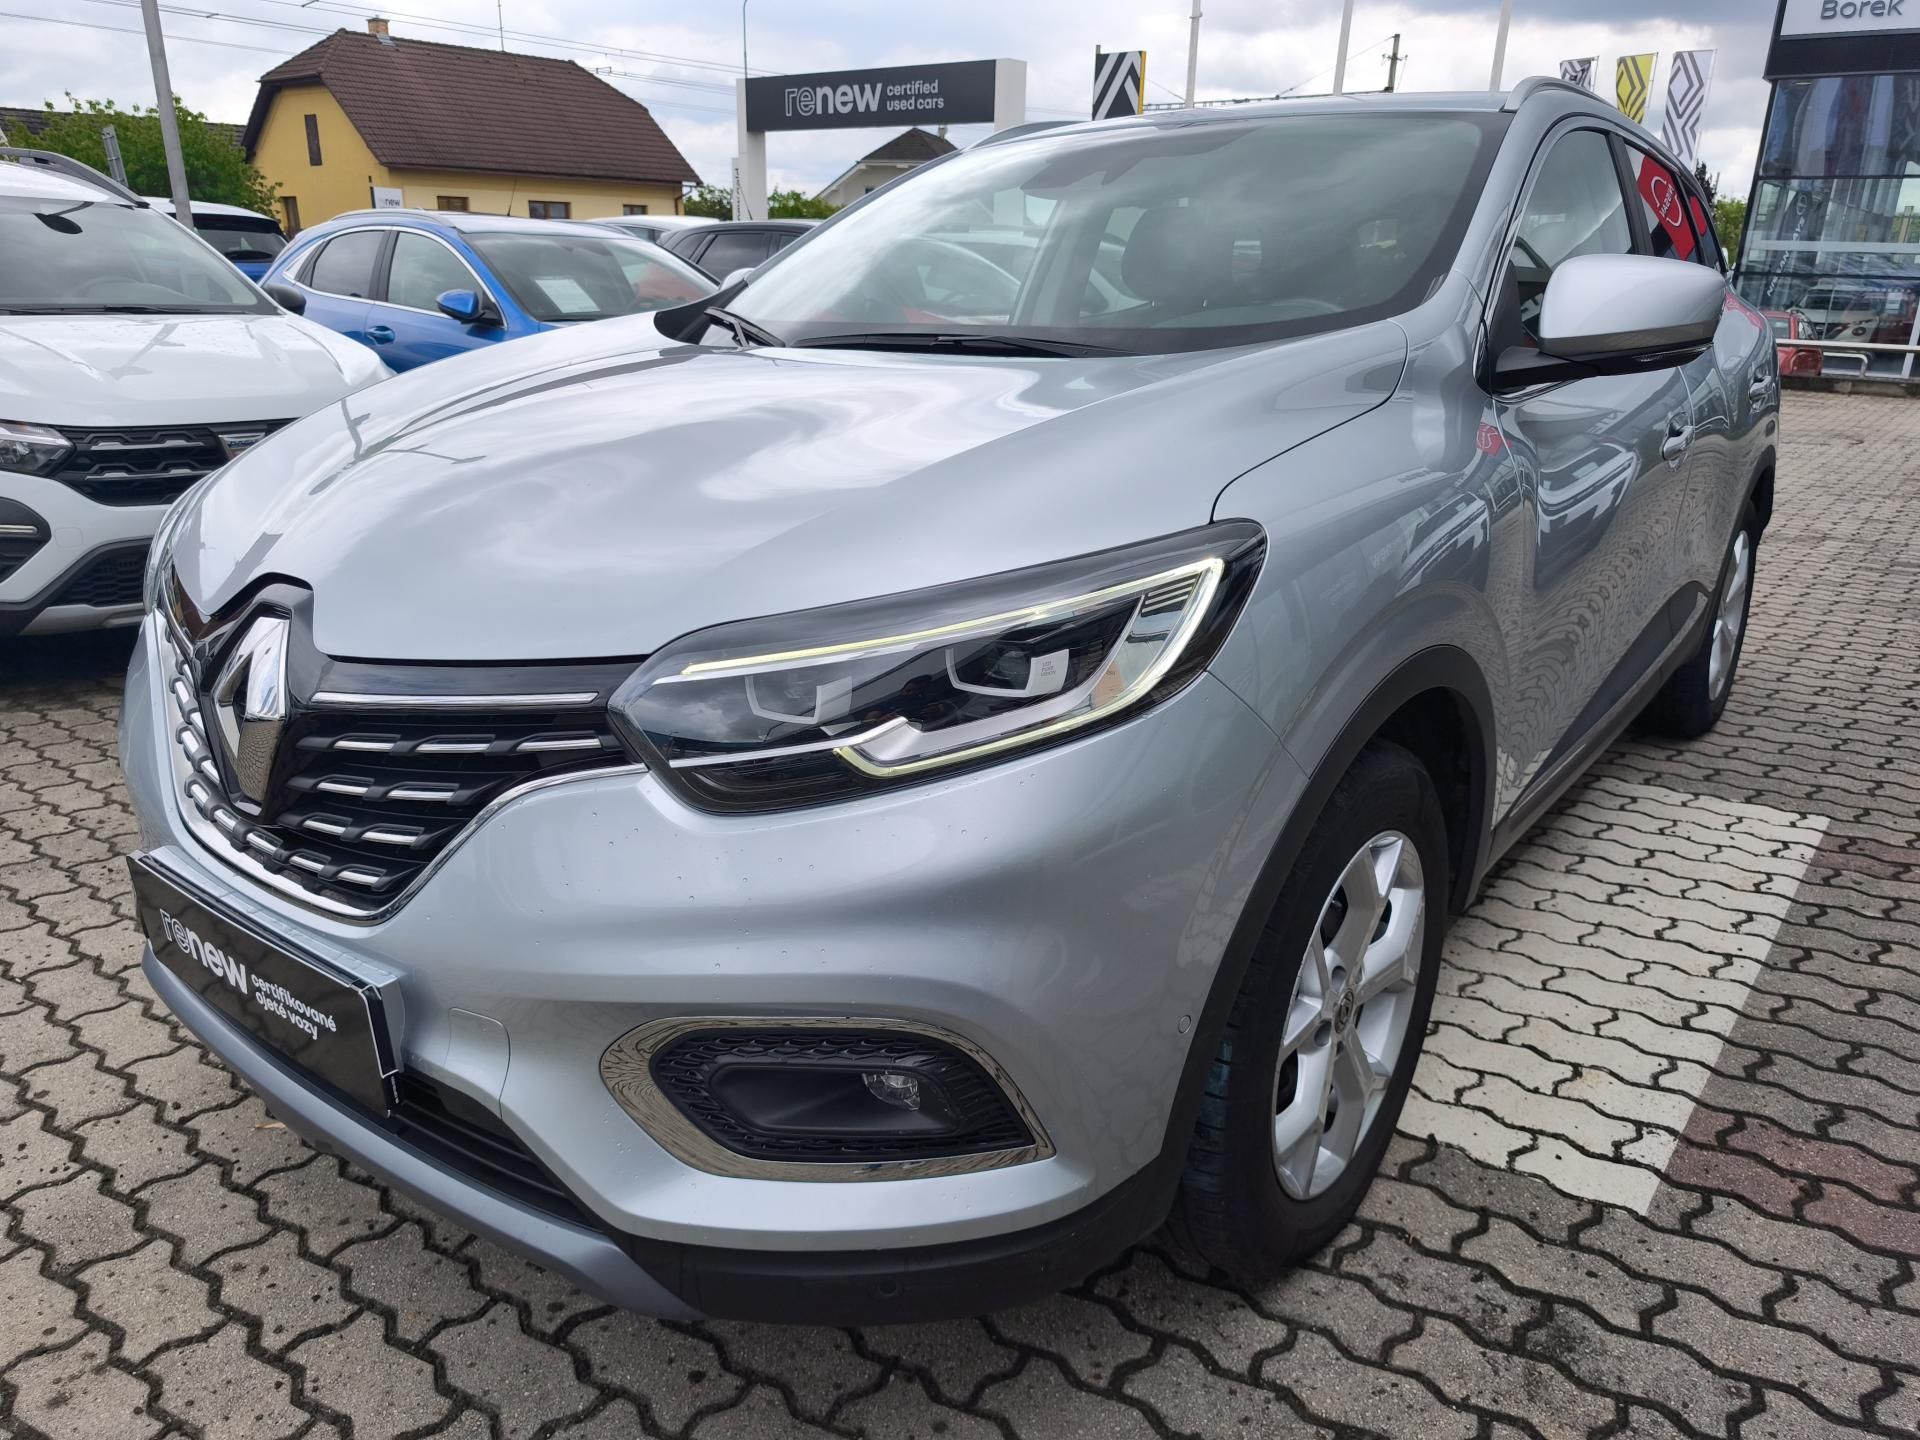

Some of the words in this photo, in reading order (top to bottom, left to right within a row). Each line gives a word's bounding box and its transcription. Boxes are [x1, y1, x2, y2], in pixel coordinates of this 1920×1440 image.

[1820, 0, 1905, 20] Borek
[784, 82, 883, 117] renew
[886, 79, 939, 97] certified
[886, 96, 915, 111] used
[916, 95, 945, 111] cars
[159, 908, 248, 995] renew
[251, 972, 337, 1033] certifikované
[255, 991, 287, 1020] ojeté
[286, 1004, 318, 1041] vozy
